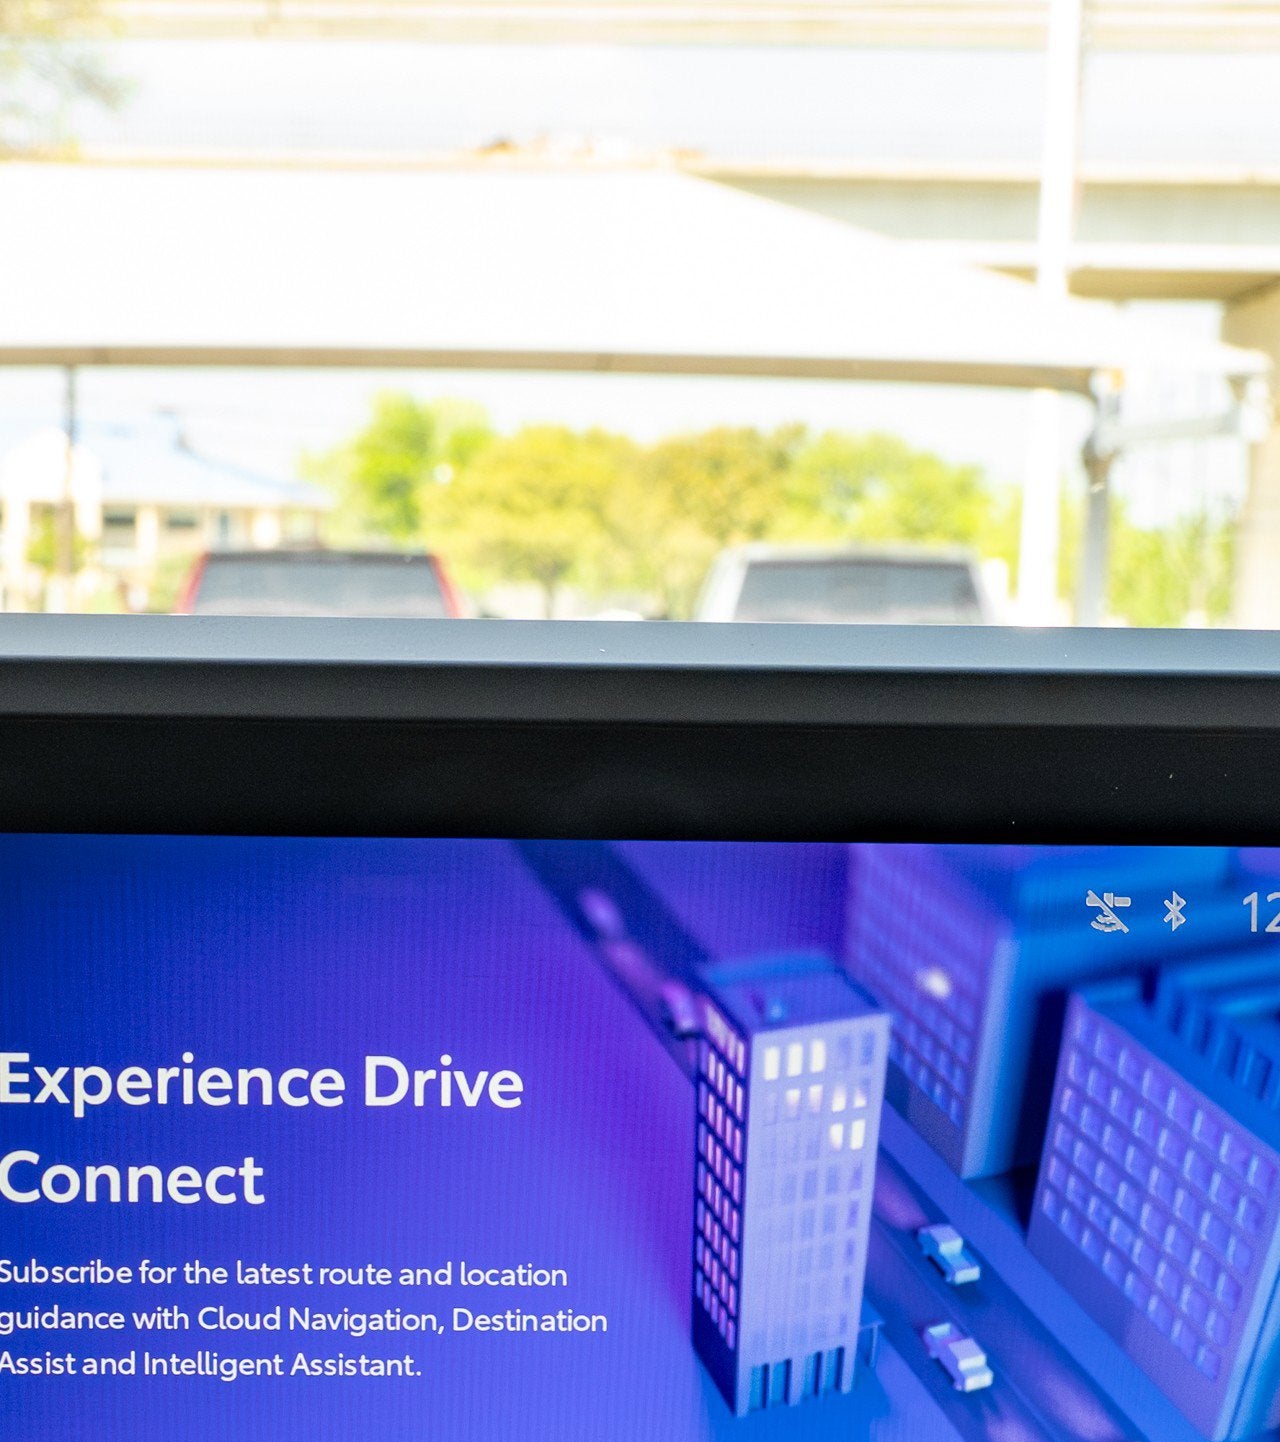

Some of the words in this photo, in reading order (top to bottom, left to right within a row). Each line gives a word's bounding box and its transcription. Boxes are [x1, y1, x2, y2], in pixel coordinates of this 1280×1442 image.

[364, 1054, 524, 1108] Drive
[138, 1259, 178, 1285] for
[183, 1260, 228, 1286] the
[236, 1260, 313, 1287] latest
[319, 1263, 392, 1287] route
[399, 1262, 453, 1287] and
[460, 1262, 568, 1288] location
[132, 1306, 189, 1331] with
[197, 1307, 281, 1332] Cloud
[289, 1308, 445, 1338] Navigation,
[453, 1309, 607, 1334] Destination
[82, 1351, 136, 1376] and
[144, 1352, 284, 1381] Intelligent
[290, 1352, 423, 1378] Assistant.
